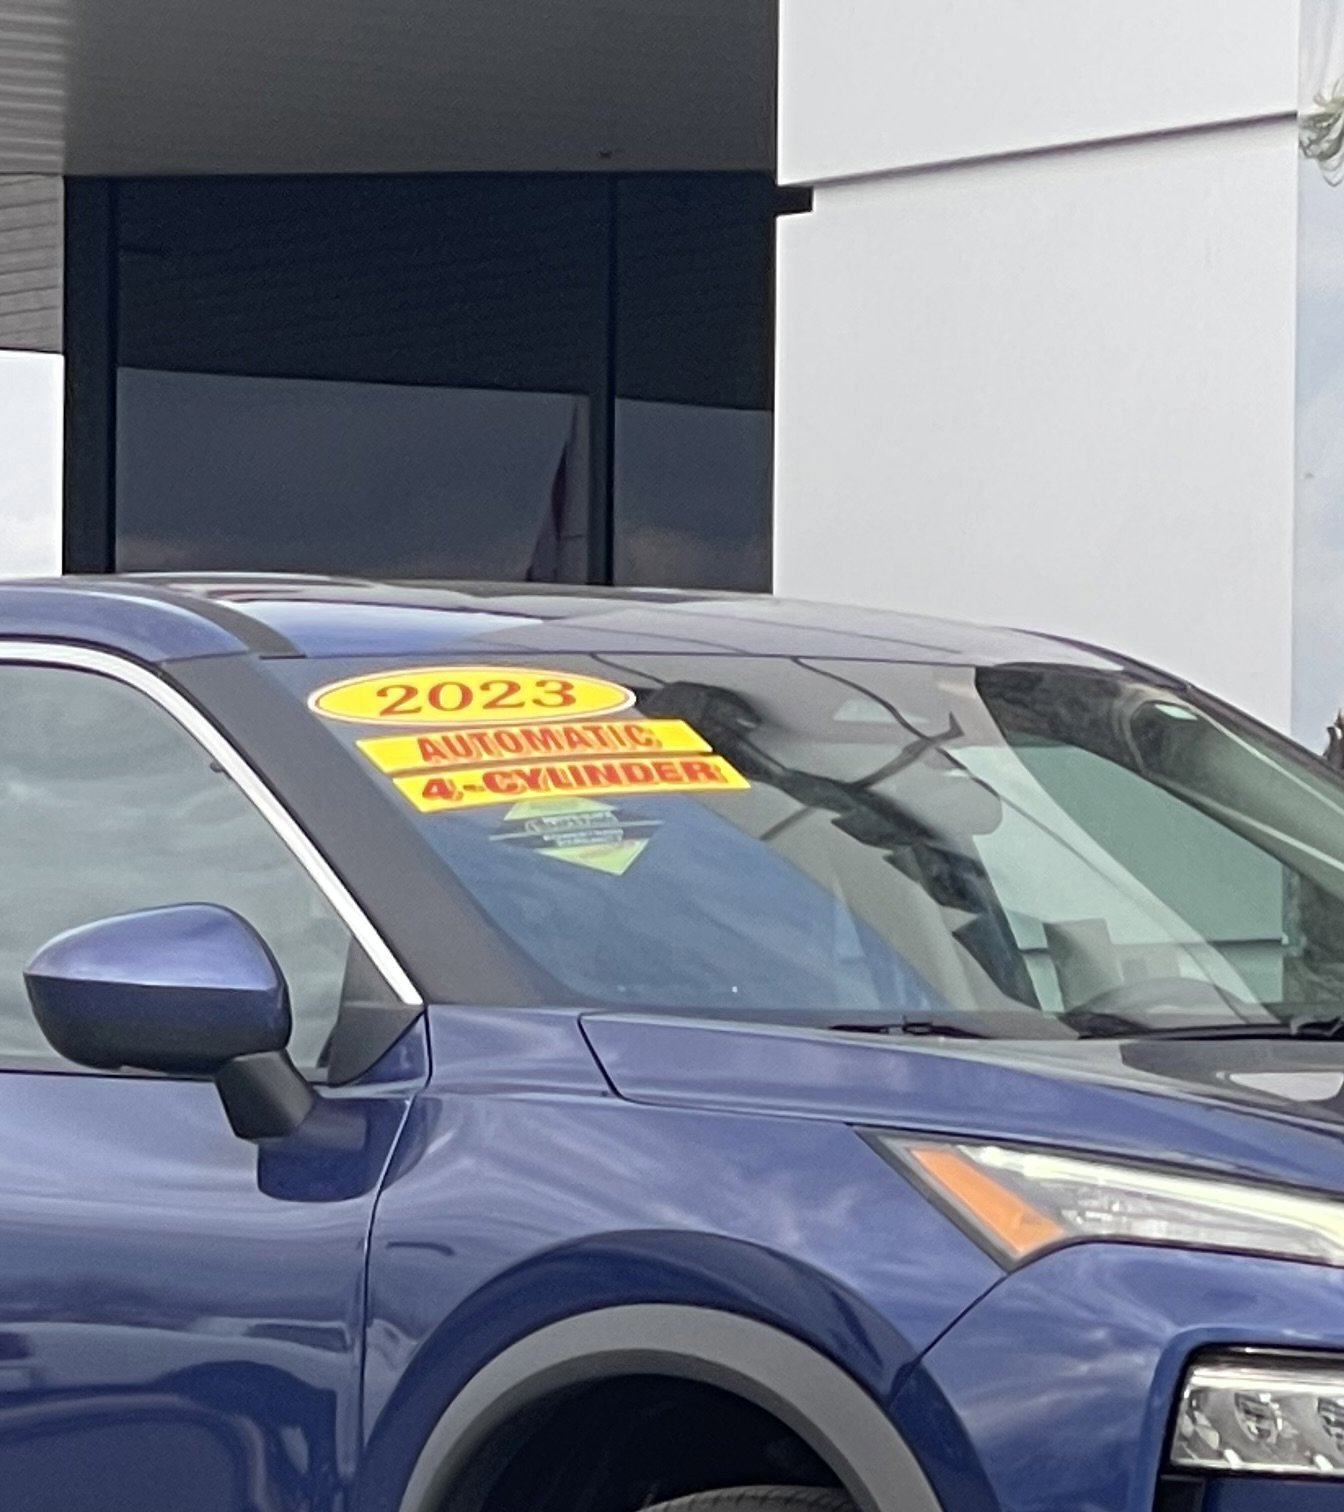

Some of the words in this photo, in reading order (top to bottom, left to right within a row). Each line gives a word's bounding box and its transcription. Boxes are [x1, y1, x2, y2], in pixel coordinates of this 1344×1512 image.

[375, 679, 577, 717] 2023
[417, 723, 657, 764] AUTOMATIC
[422, 760, 723, 802] 4-CYLINDER
